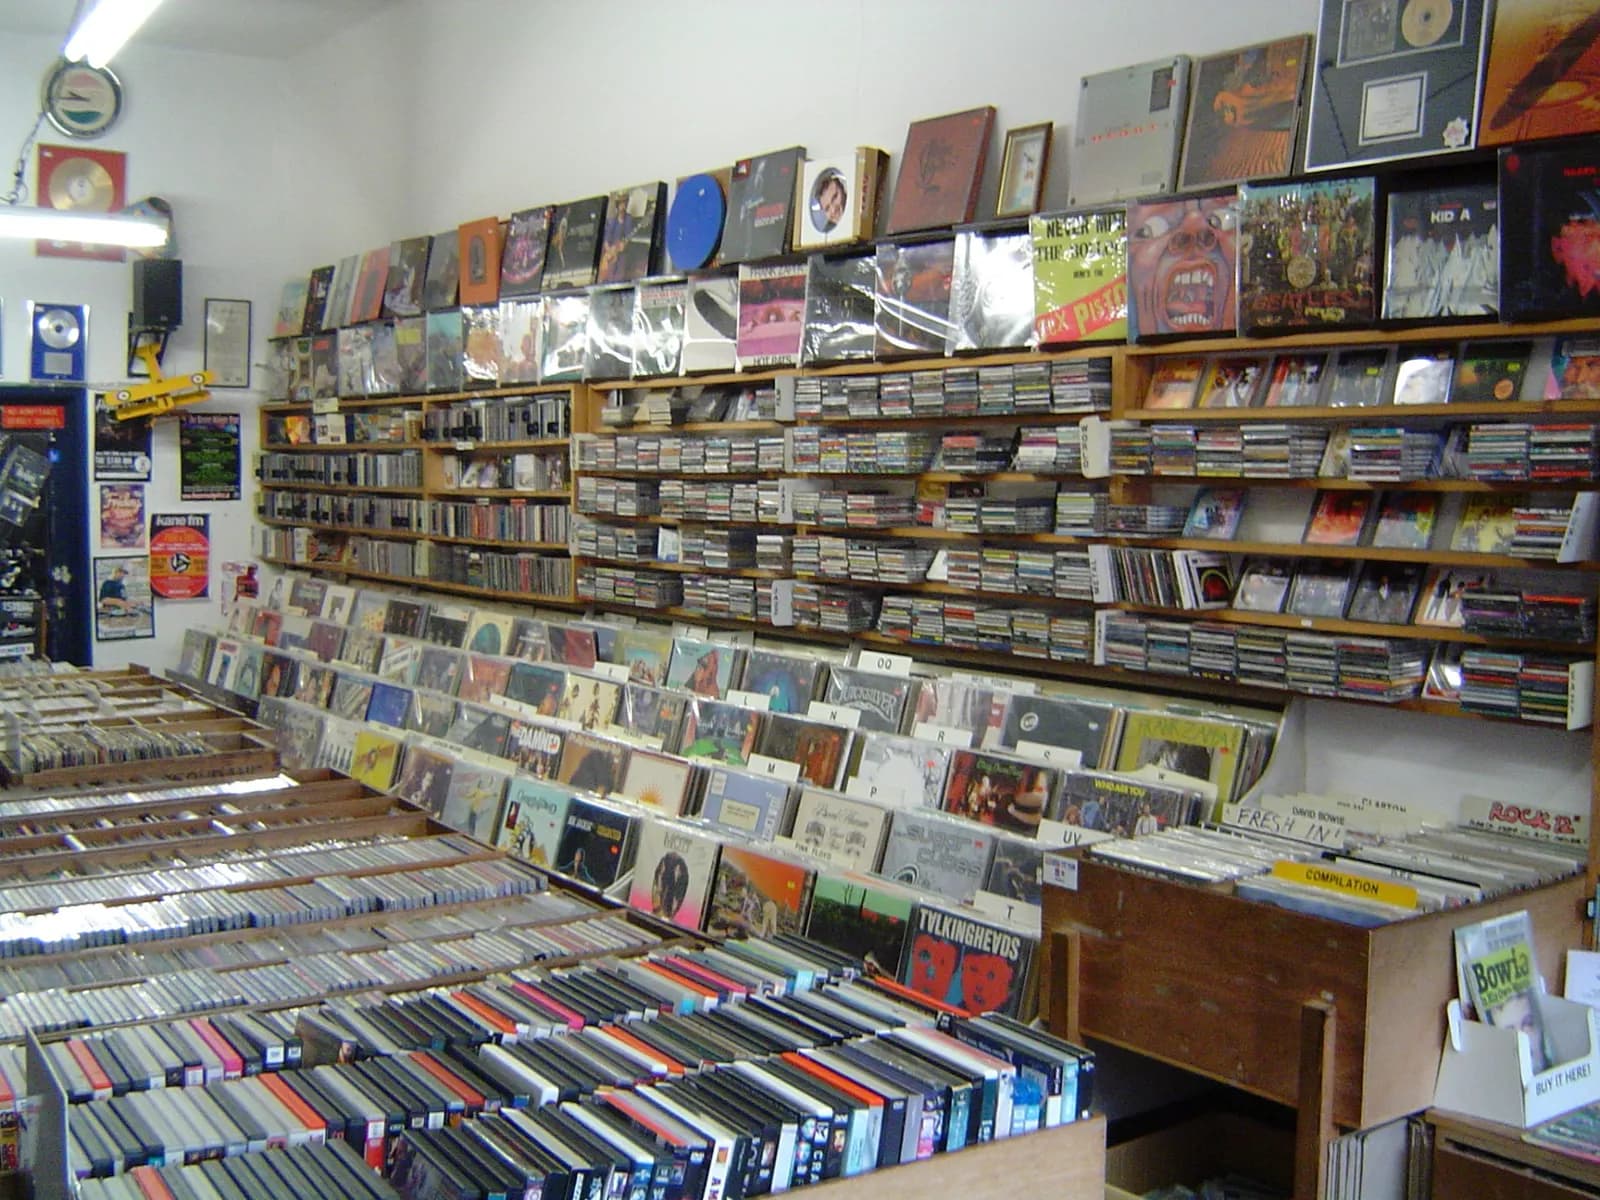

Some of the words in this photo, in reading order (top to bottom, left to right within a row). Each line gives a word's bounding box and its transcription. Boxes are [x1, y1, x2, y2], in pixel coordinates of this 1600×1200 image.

[1430, 210, 1454, 223] KID
[1460, 208, 1470, 221] A
[1046, 217, 1089, 238] NEVER
[1081, 424, 1089, 468] WORLD
[156, 514, 186, 526] kane
[188, 513, 204, 526] fm
[828, 683, 897, 722] QUICKSILVER
[829, 711, 838, 721] N
[937, 731, 945, 742] R
[767, 762, 776, 774] M
[869, 786, 878, 798] P
[1237, 807, 1296, 833] FRESH
[1292, 806, 1315, 819] DAVID
[1318, 811, 1345, 825] BOWIE
[1488, 800, 1551, 831] ROCK
[1063, 830, 1082, 847] UV
[811, 847, 832, 860] FLOYD
[1305, 868, 1379, 895] COMPILATION
[1007, 904, 1014, 920] T
[1535, 1077, 1552, 1097] BUY
[1555, 1072, 1563, 1088] IT
[1565, 1063, 1592, 1085] HERE!
